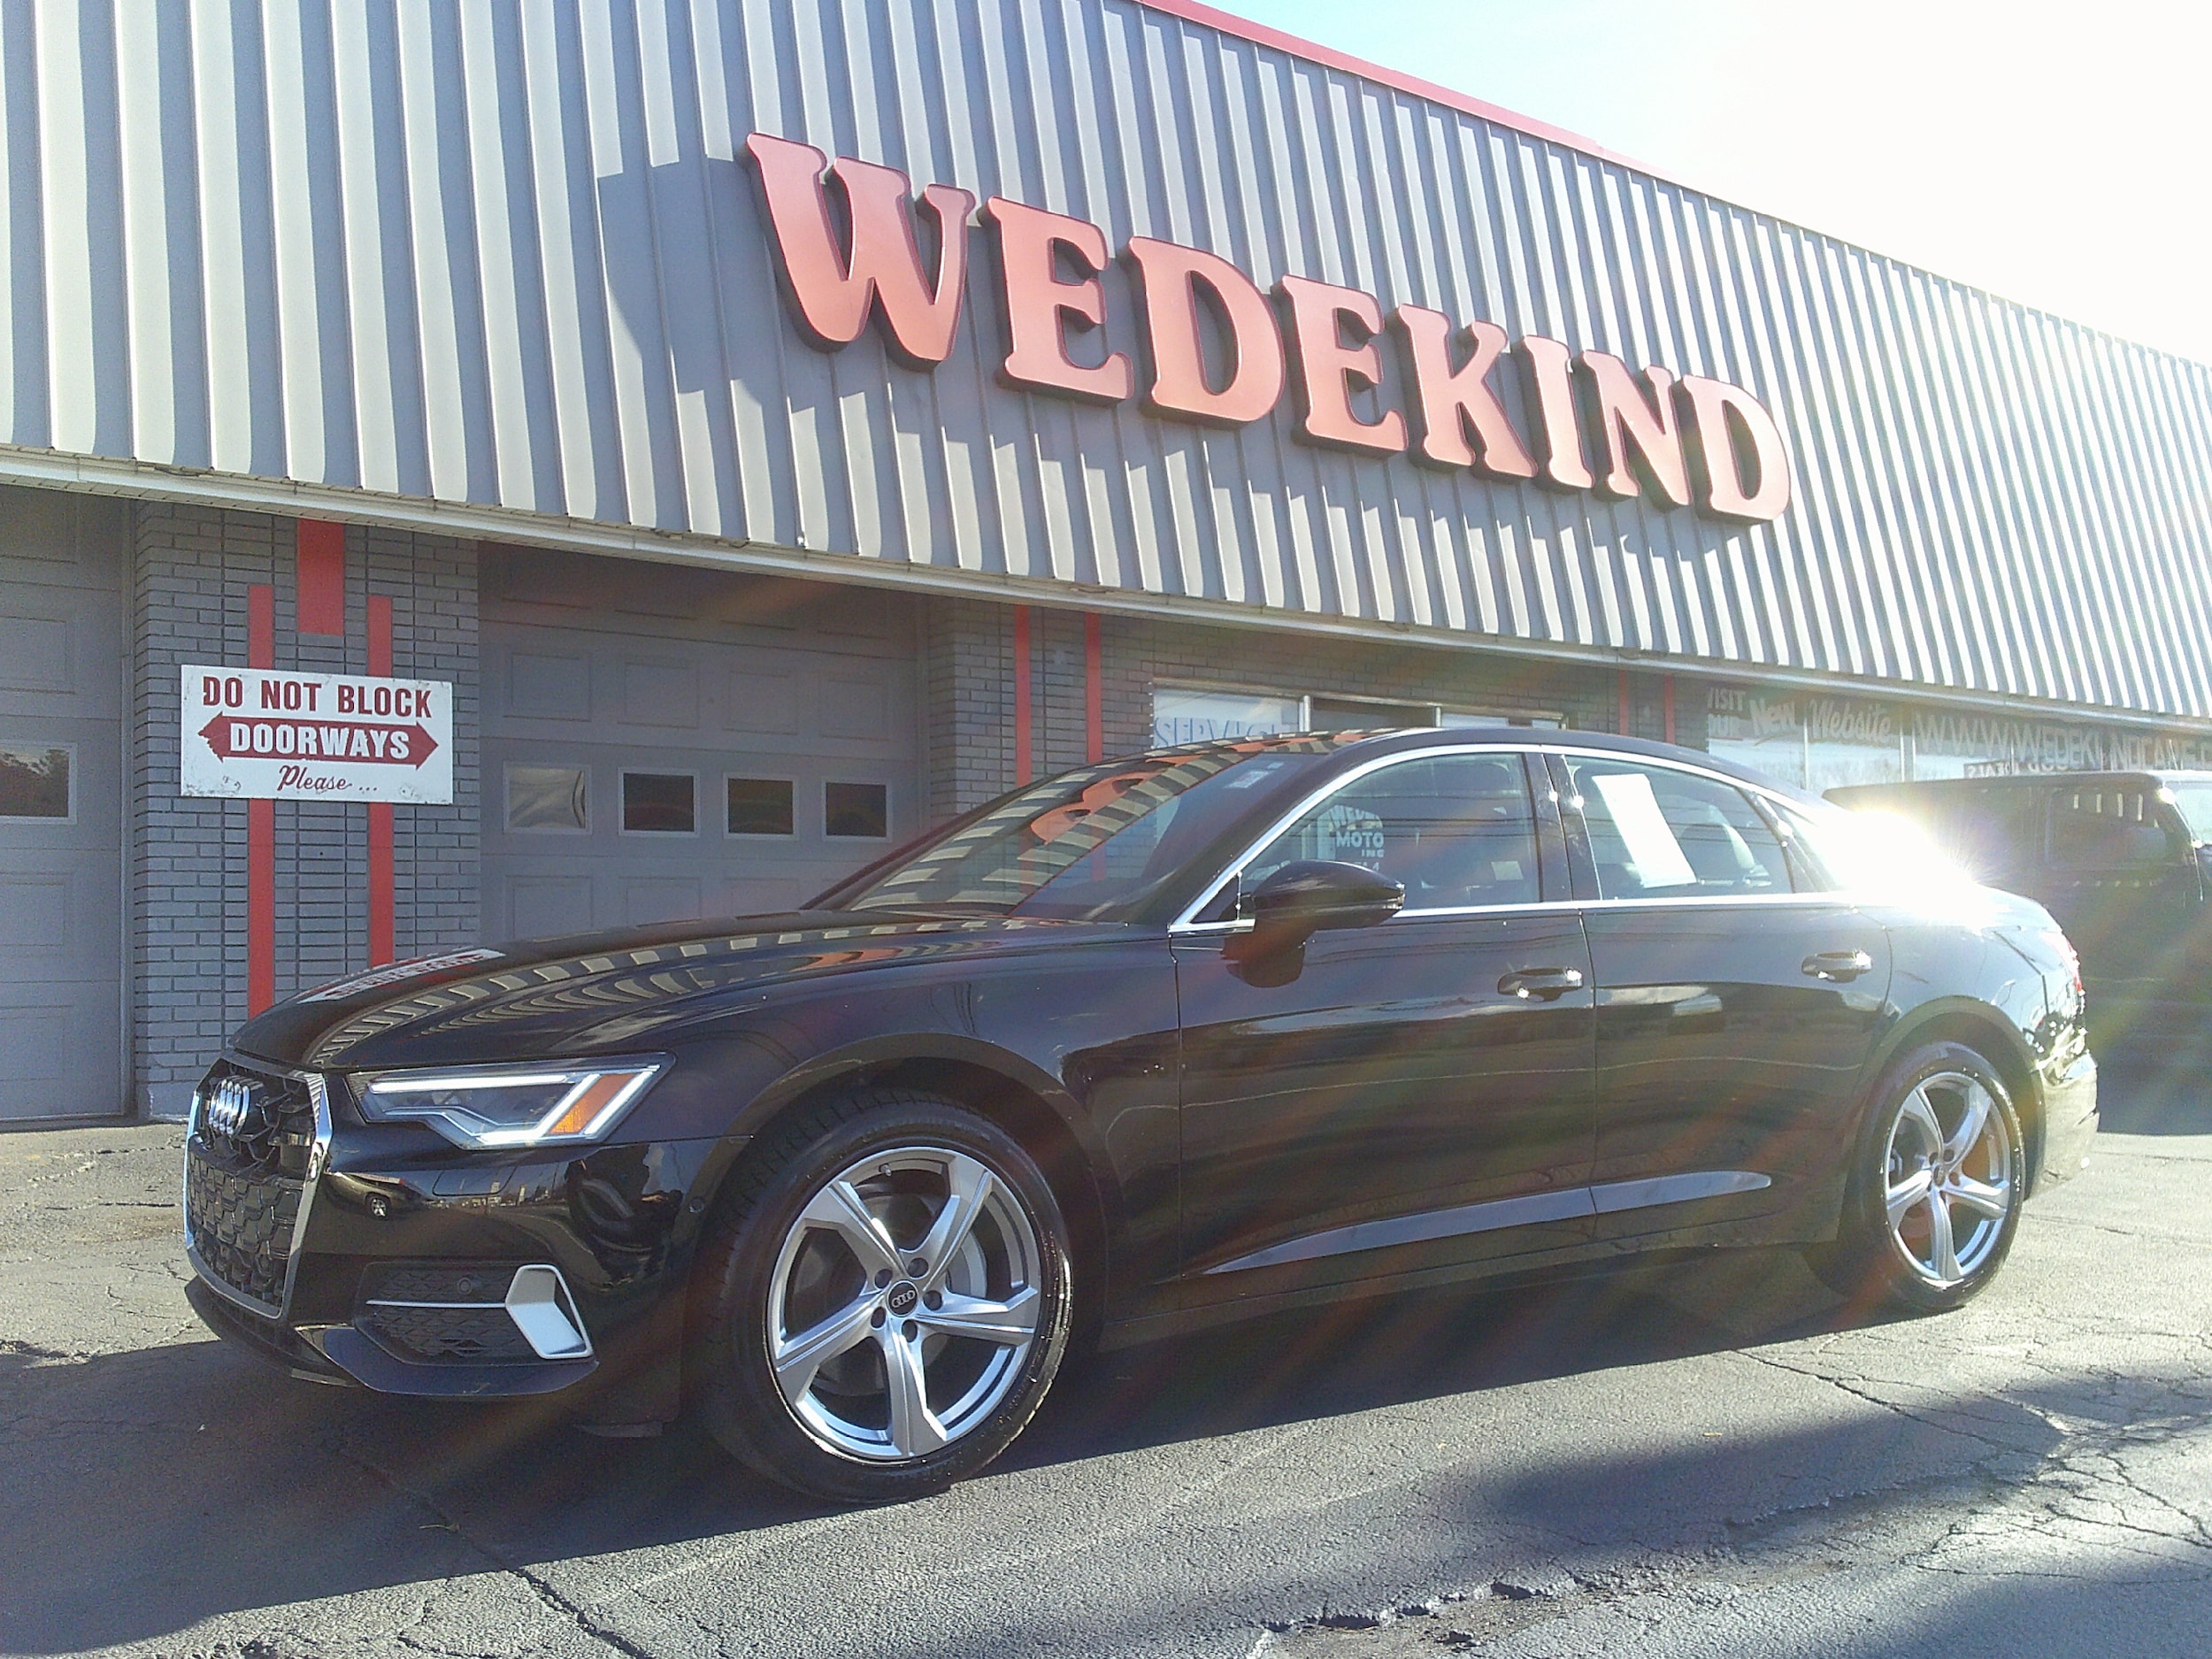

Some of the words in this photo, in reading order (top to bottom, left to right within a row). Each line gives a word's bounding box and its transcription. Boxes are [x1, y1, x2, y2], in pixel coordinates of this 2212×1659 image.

[743, 131, 1793, 526] WEDEKIND
[203, 676, 243, 708] DO
[261, 680, 322, 712] NOT
[338, 684, 433, 718] BLOCK
[230, 722, 410, 759] DOORWAYS
[277, 764, 353, 791] Please
